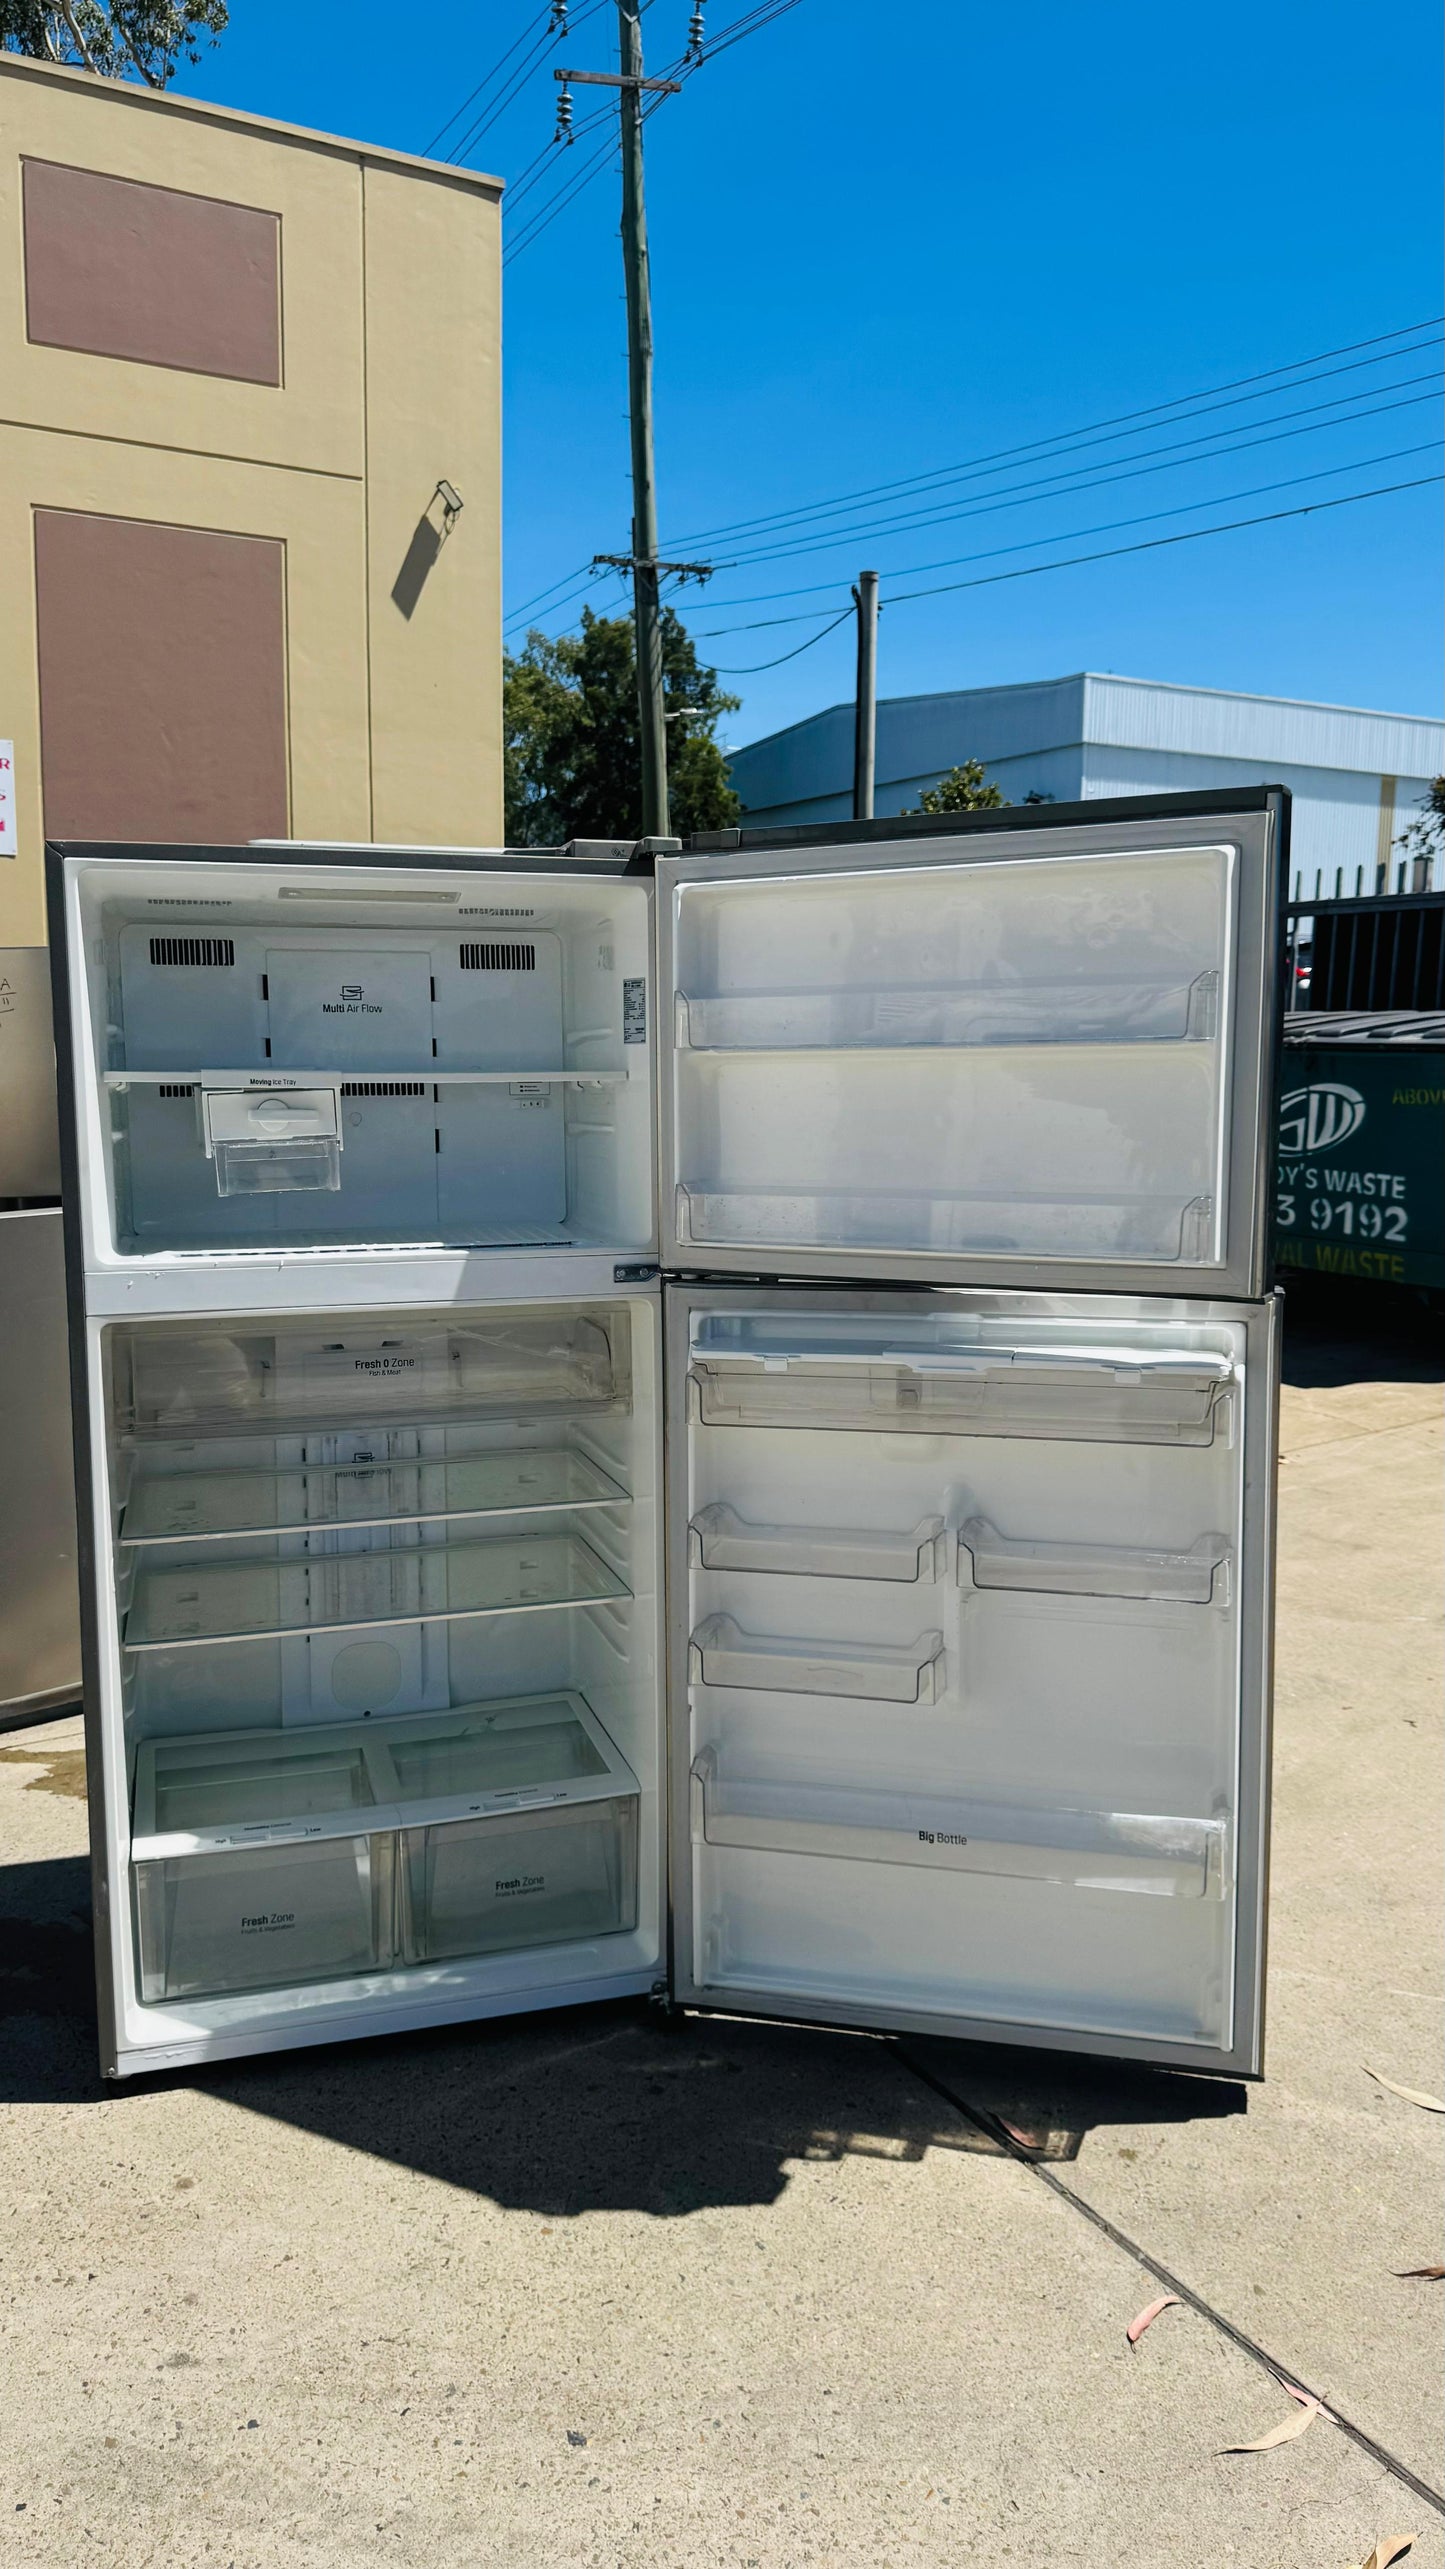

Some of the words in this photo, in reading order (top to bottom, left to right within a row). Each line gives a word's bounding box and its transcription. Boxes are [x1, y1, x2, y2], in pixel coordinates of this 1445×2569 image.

[322, 1003, 345, 1013] Multi
[347, 1004, 360, 1013] Air
[361, 1003, 383, 1013] Flow
[249, 1078, 272, 1086] Moving
[283, 1078, 297, 1086] Tray
[1324, 1168, 1406, 1200] WASTE
[1276, 1194, 1296, 1226] 3
[1310, 1198, 1408, 1242] 9192
[1315, 1243, 1405, 1283] WASTE
[355, 1359, 382, 1370] Fresh
[391, 1358, 415, 1368] Zone
[919, 1830, 935, 1844] Big
[936, 1832, 968, 1846] Bottle
[495, 1878, 520, 1890] Fresh
[522, 1876, 545, 1887] Zone
[241, 1914, 269, 1927] Fresh
[270, 1913, 295, 1924] Zone
